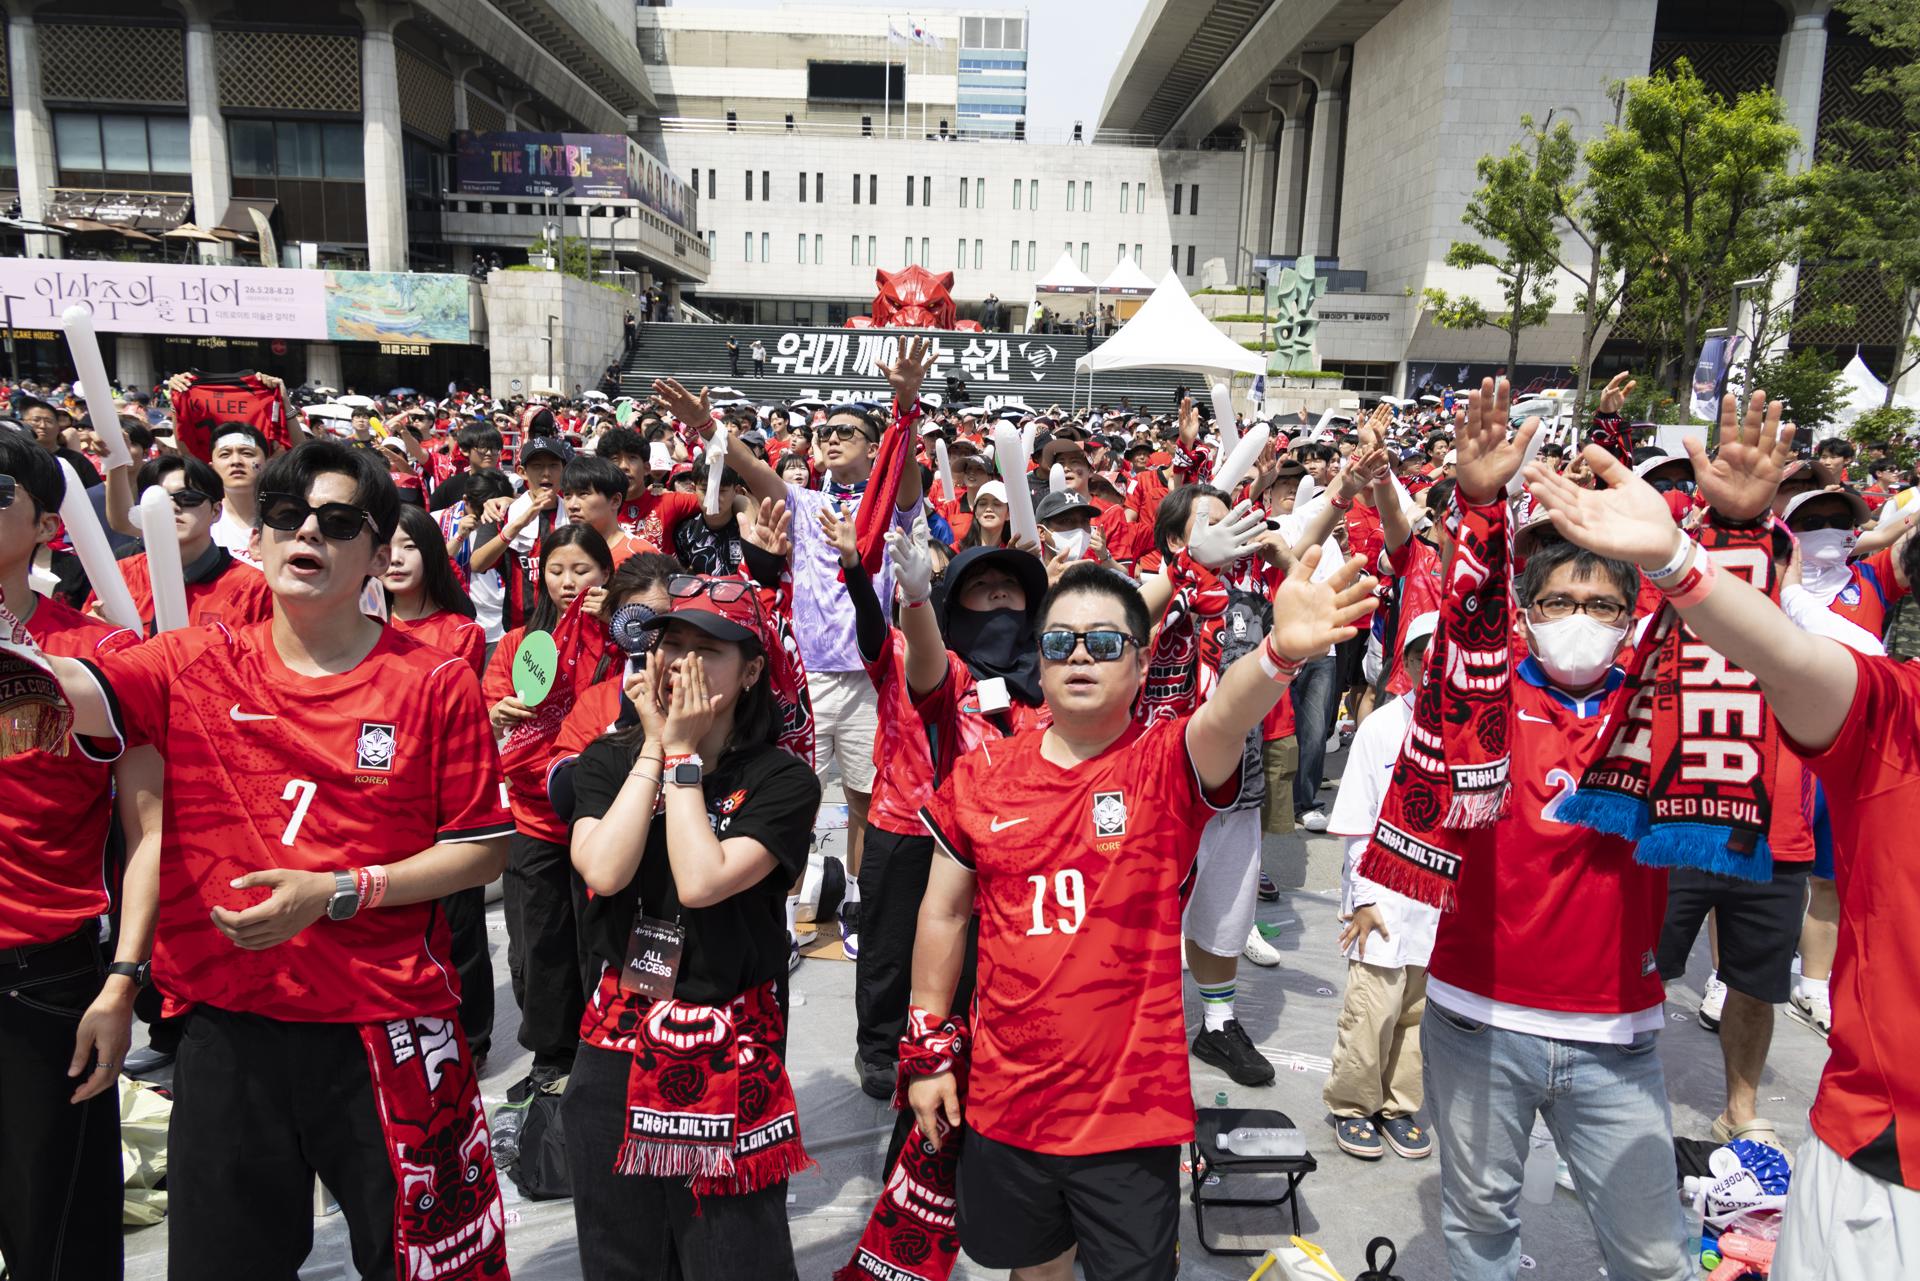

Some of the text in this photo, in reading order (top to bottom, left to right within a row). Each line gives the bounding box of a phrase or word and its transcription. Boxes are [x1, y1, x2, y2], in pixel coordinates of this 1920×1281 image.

[491, 144, 593, 178] THE TRIBE
[180, 277, 240, 324] 넘어
[770, 332, 850, 377] 우리가
[961, 338, 1010, 382] 순간
[216, 400, 249, 414] LEE
[522, 650, 547, 686] SkyLife
[354, 775, 389, 786] KOREA
[1586, 771, 1619, 786] RED
[1540, 767, 1581, 823] 2
[280, 778, 318, 847] 7
[1656, 798, 1762, 824] RED DEVIL
[1096, 841, 1122, 852] KORE
[1026, 868, 1087, 937] 19
[630, 958, 672, 978] ACCESS
[643, 949, 663, 964] ALL
